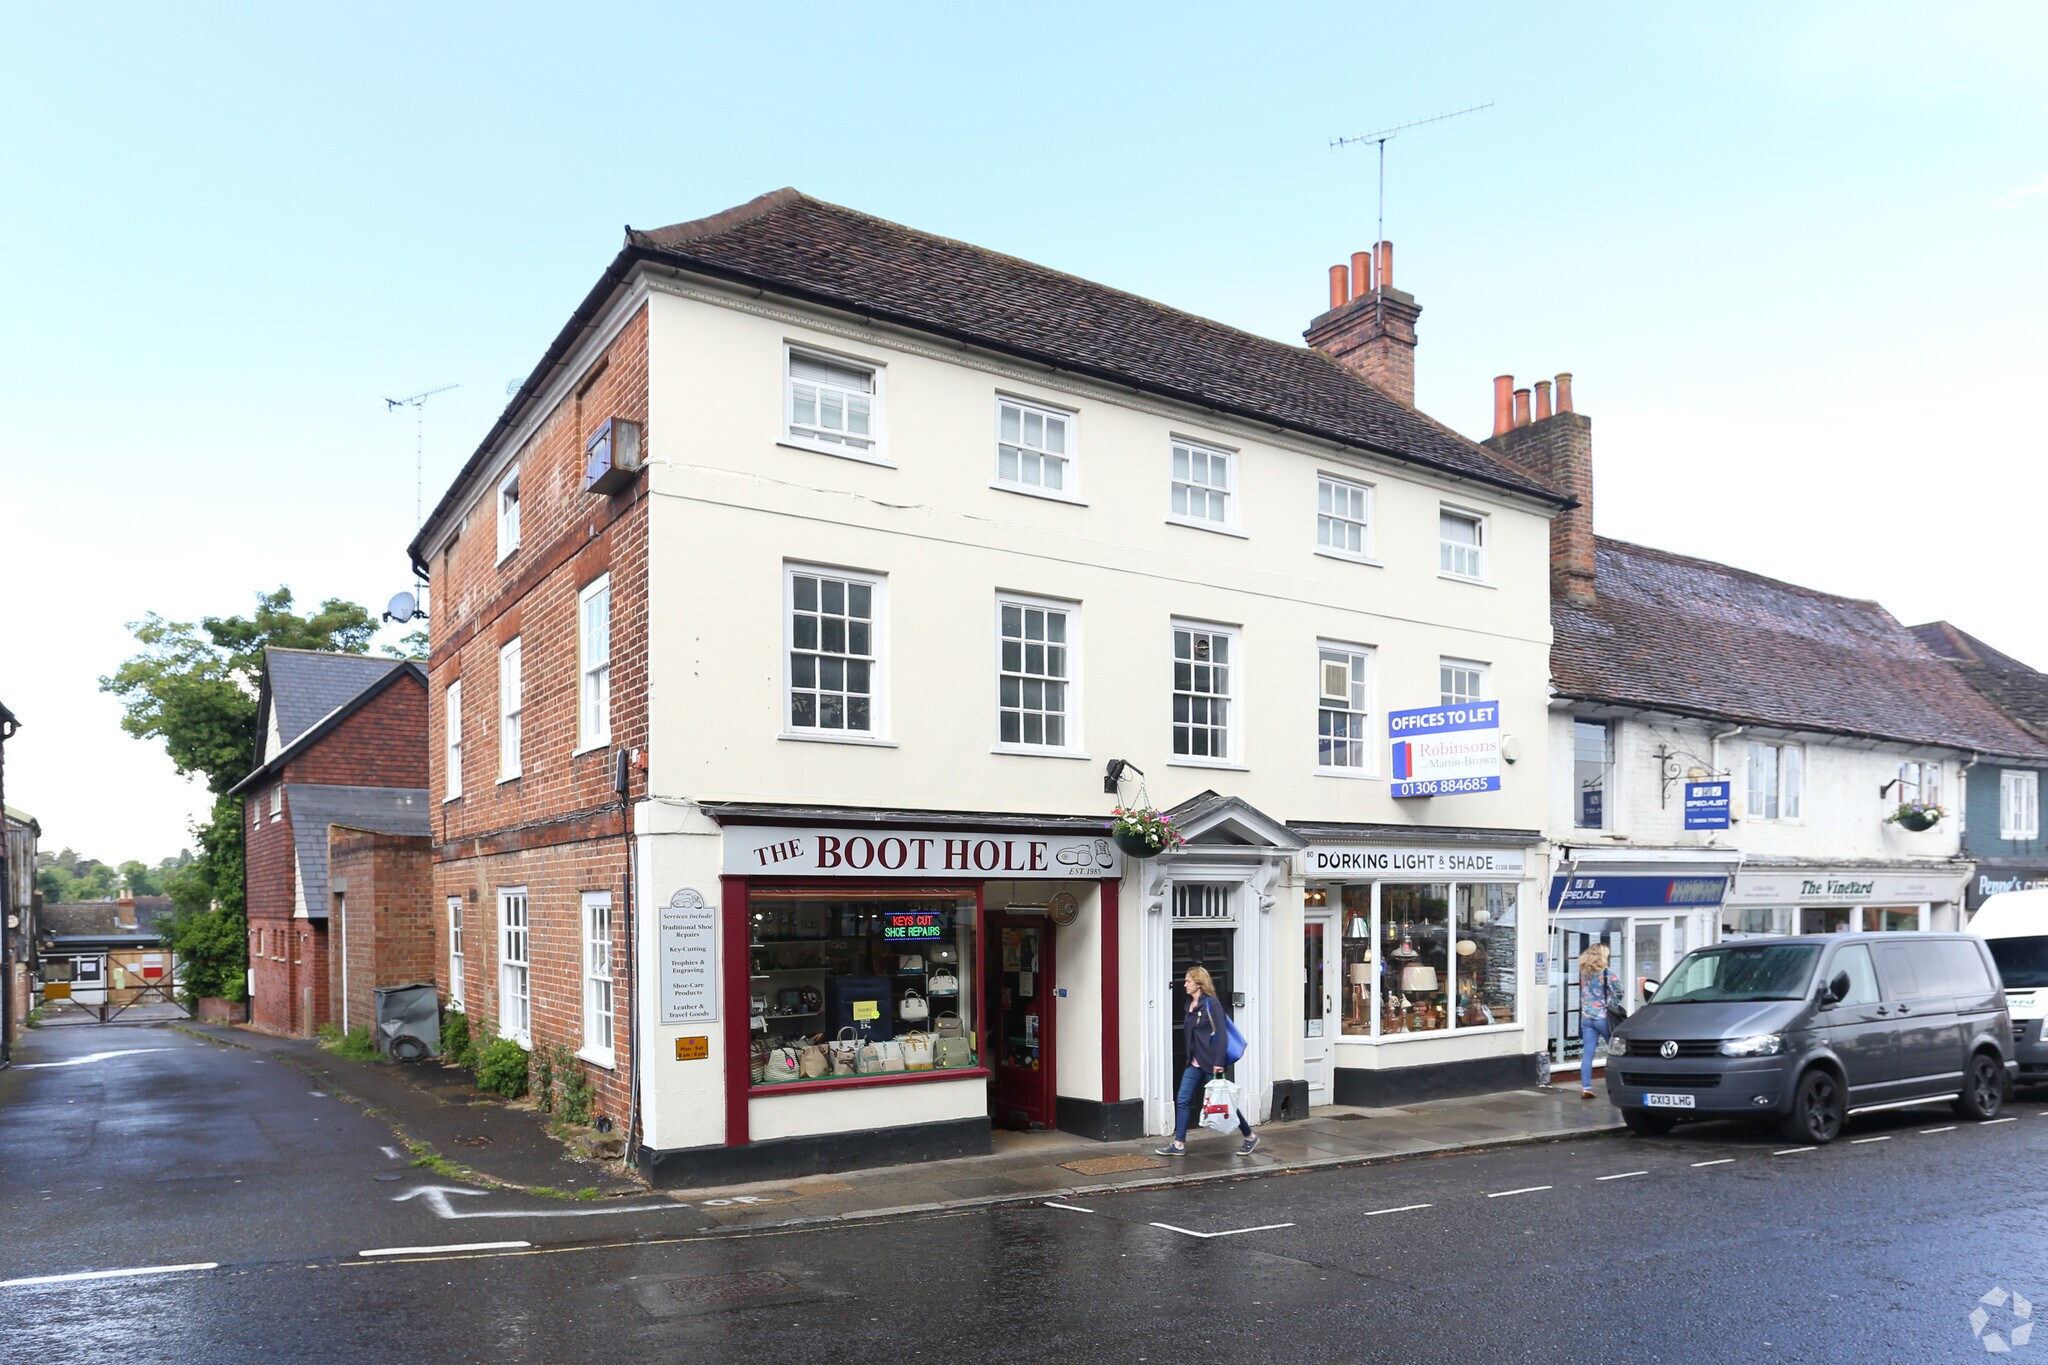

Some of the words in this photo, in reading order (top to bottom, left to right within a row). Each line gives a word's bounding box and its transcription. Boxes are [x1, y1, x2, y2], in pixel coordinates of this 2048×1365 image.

[1392, 712, 1445, 730] OFFICES
[1447, 710, 1466, 725] TO
[1469, 707, 1495, 723] LET
[1420, 741, 1496, 757] Robinsons
[1430, 756, 1497, 769] Martin-Brown
[1401, 781, 1437, 795] 01306
[1440, 778, 1488, 792] 884685
[1686, 799, 1728, 807] SPECIALIST
[753, 838, 804, 867] THE
[814, 835, 934, 870] BOOT
[943, 838, 1048, 871] HOLE
[1318, 852, 1388, 869] DORKING
[1394, 854, 1434, 869] LIGHT
[1438, 856, 1445, 866] &
[1449, 855, 1493, 870] SHADE
[1801, 880, 1822, 894] The
[892, 916, 913, 926] KEYS
[917, 915, 933, 925] CUT
[885, 927, 905, 937] SHOE
[908, 926, 940, 937] REPAIRS
[1651, 1095, 1670, 1105] GX13
[1673, 1096, 1691, 1106] LHG
